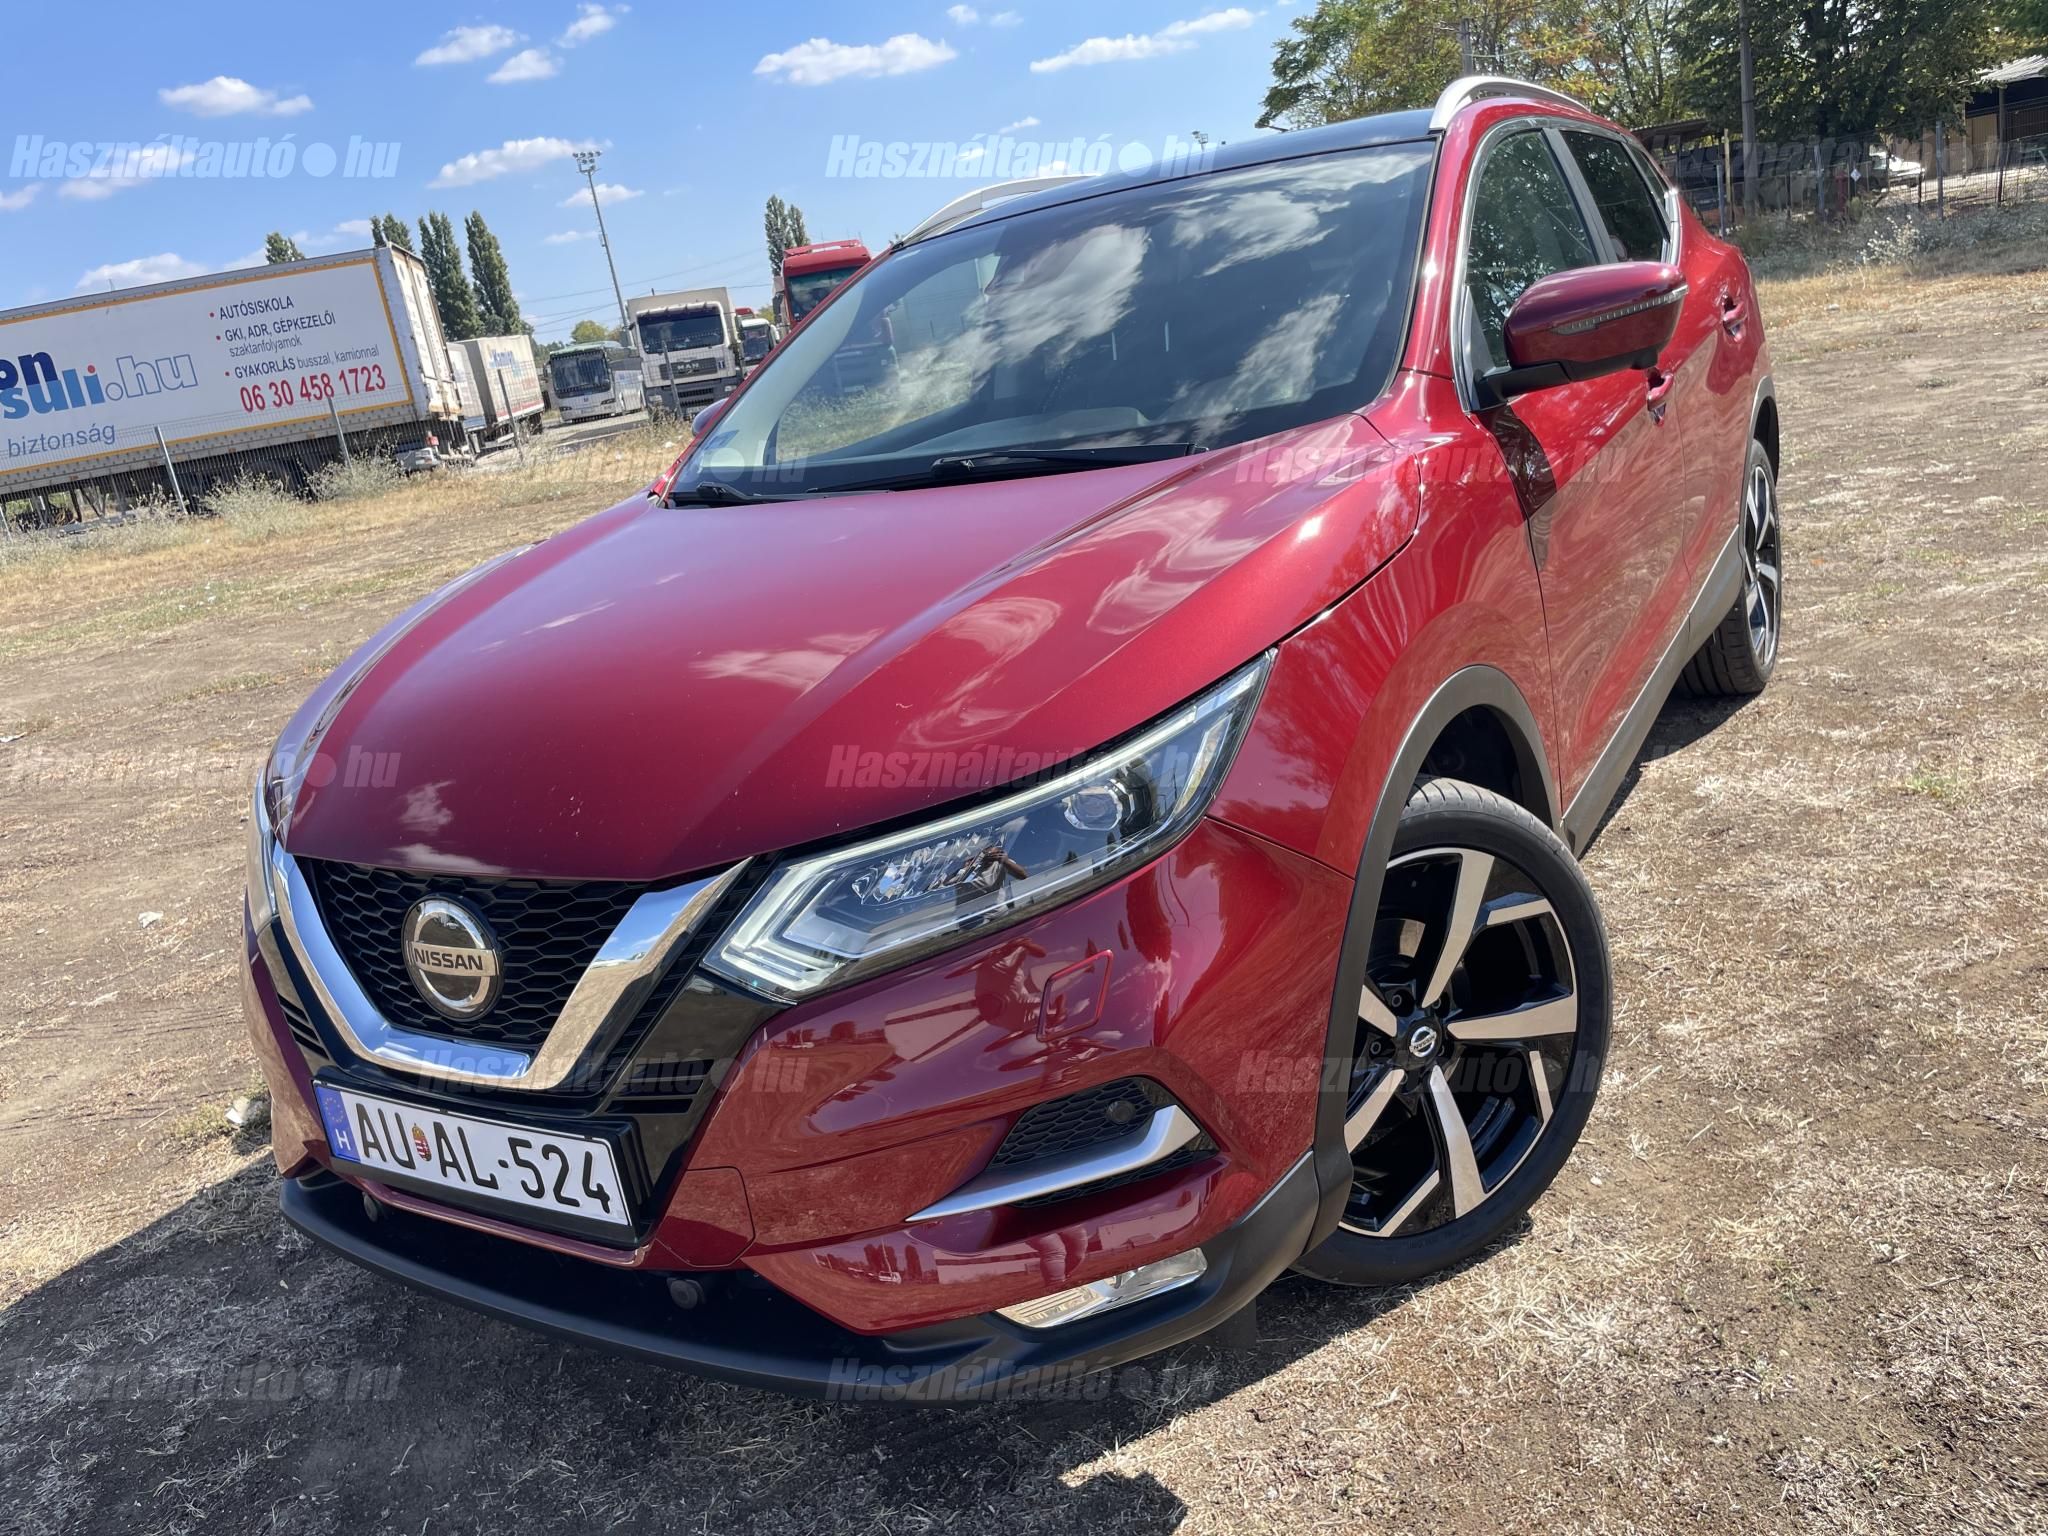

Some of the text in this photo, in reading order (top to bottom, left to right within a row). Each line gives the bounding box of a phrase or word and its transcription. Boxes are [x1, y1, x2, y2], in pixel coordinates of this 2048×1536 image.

[220, 296, 294, 320] AUTÓSISKOLA
[225, 310, 336, 341] GKI, ADR, GÉPKEZELŐI
[229, 335, 303, 358] szaktanfolyamok
[234, 344, 379, 379] GYAKORLÁS busszal, kamionnal
[677, 362, 699, 370] MAN
[240, 364, 386, 413] 06 30 458 1723
[8, 423, 116, 458] biztonság
[414, 948, 484, 971] NISSAN
[336, 1128, 351, 1150] H
